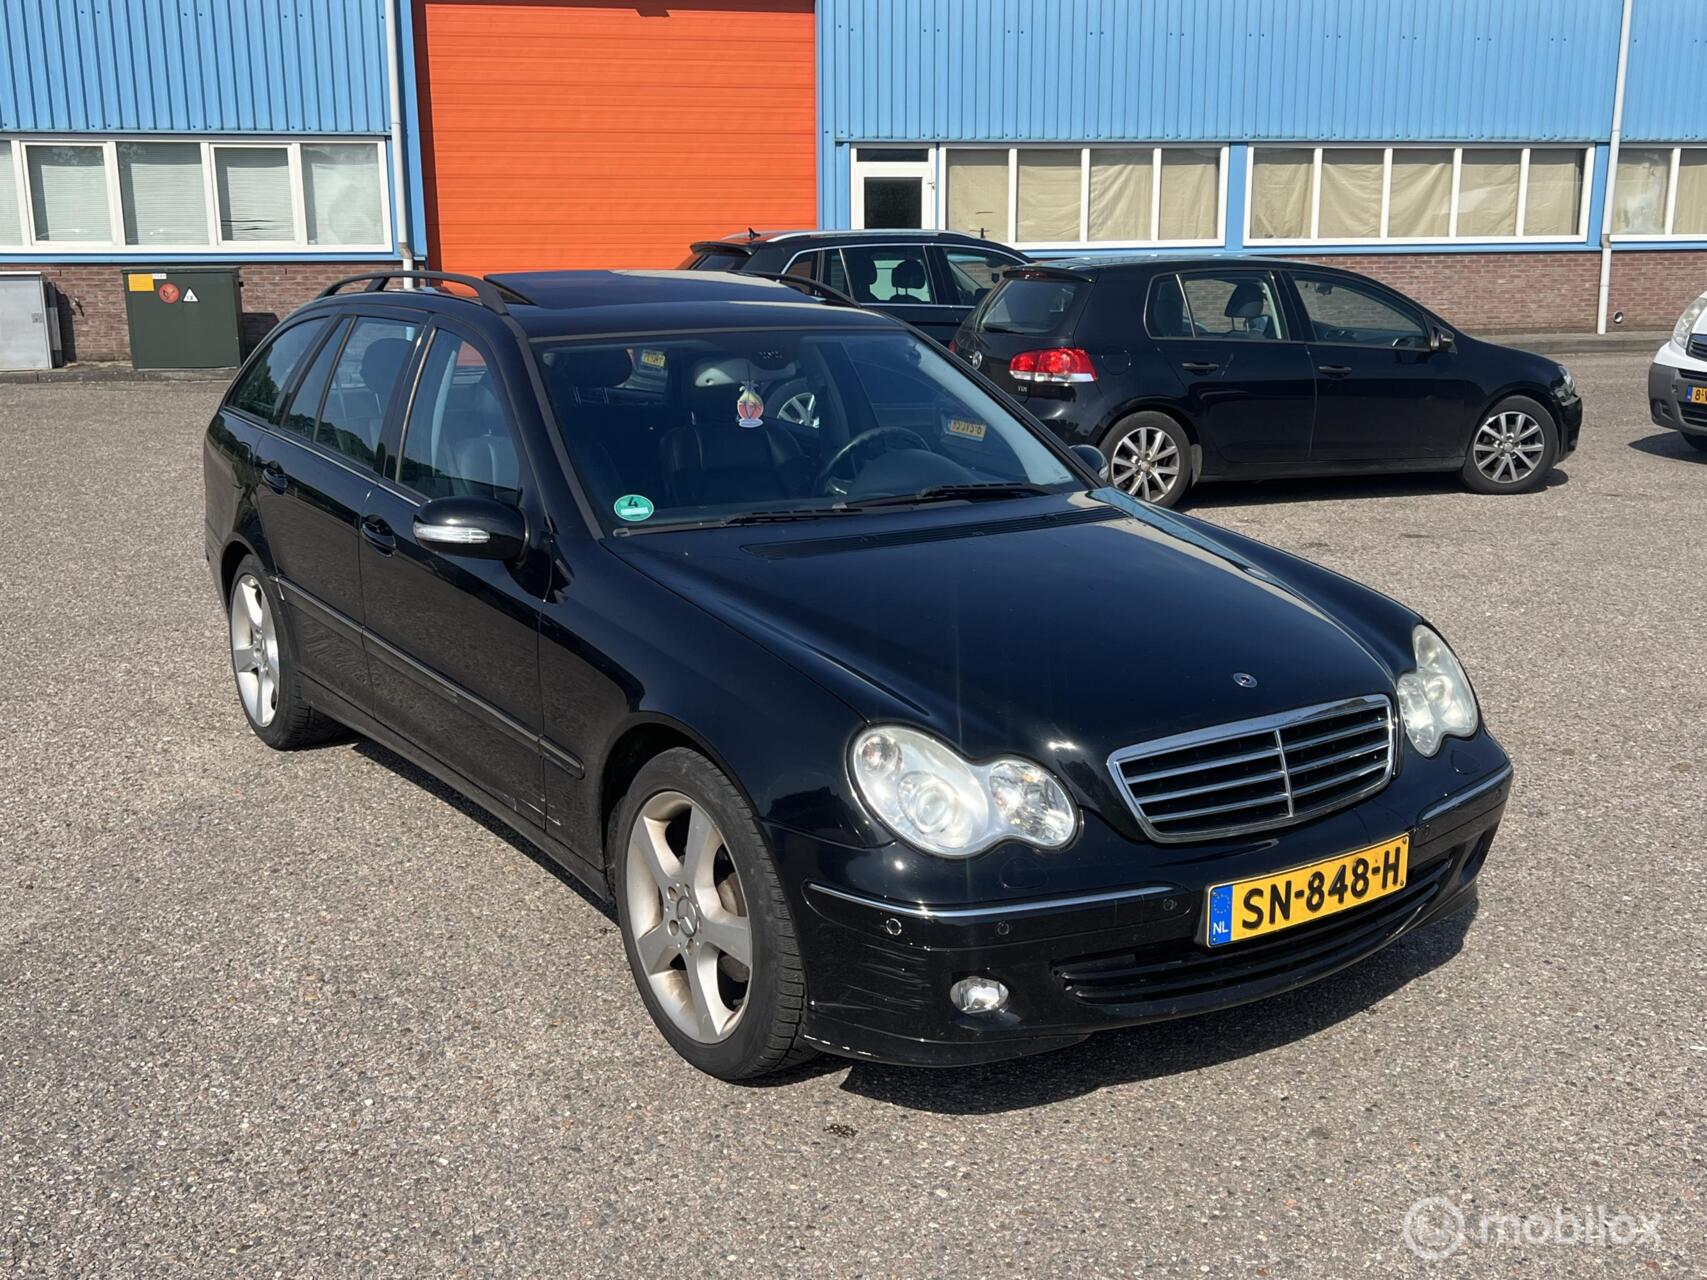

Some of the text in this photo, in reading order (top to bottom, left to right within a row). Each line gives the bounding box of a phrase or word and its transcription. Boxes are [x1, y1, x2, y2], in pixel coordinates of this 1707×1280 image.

[627, 496, 639, 508] 4
[1242, 846, 1401, 930] SN-848-H
[1212, 920, 1230, 936] NL
